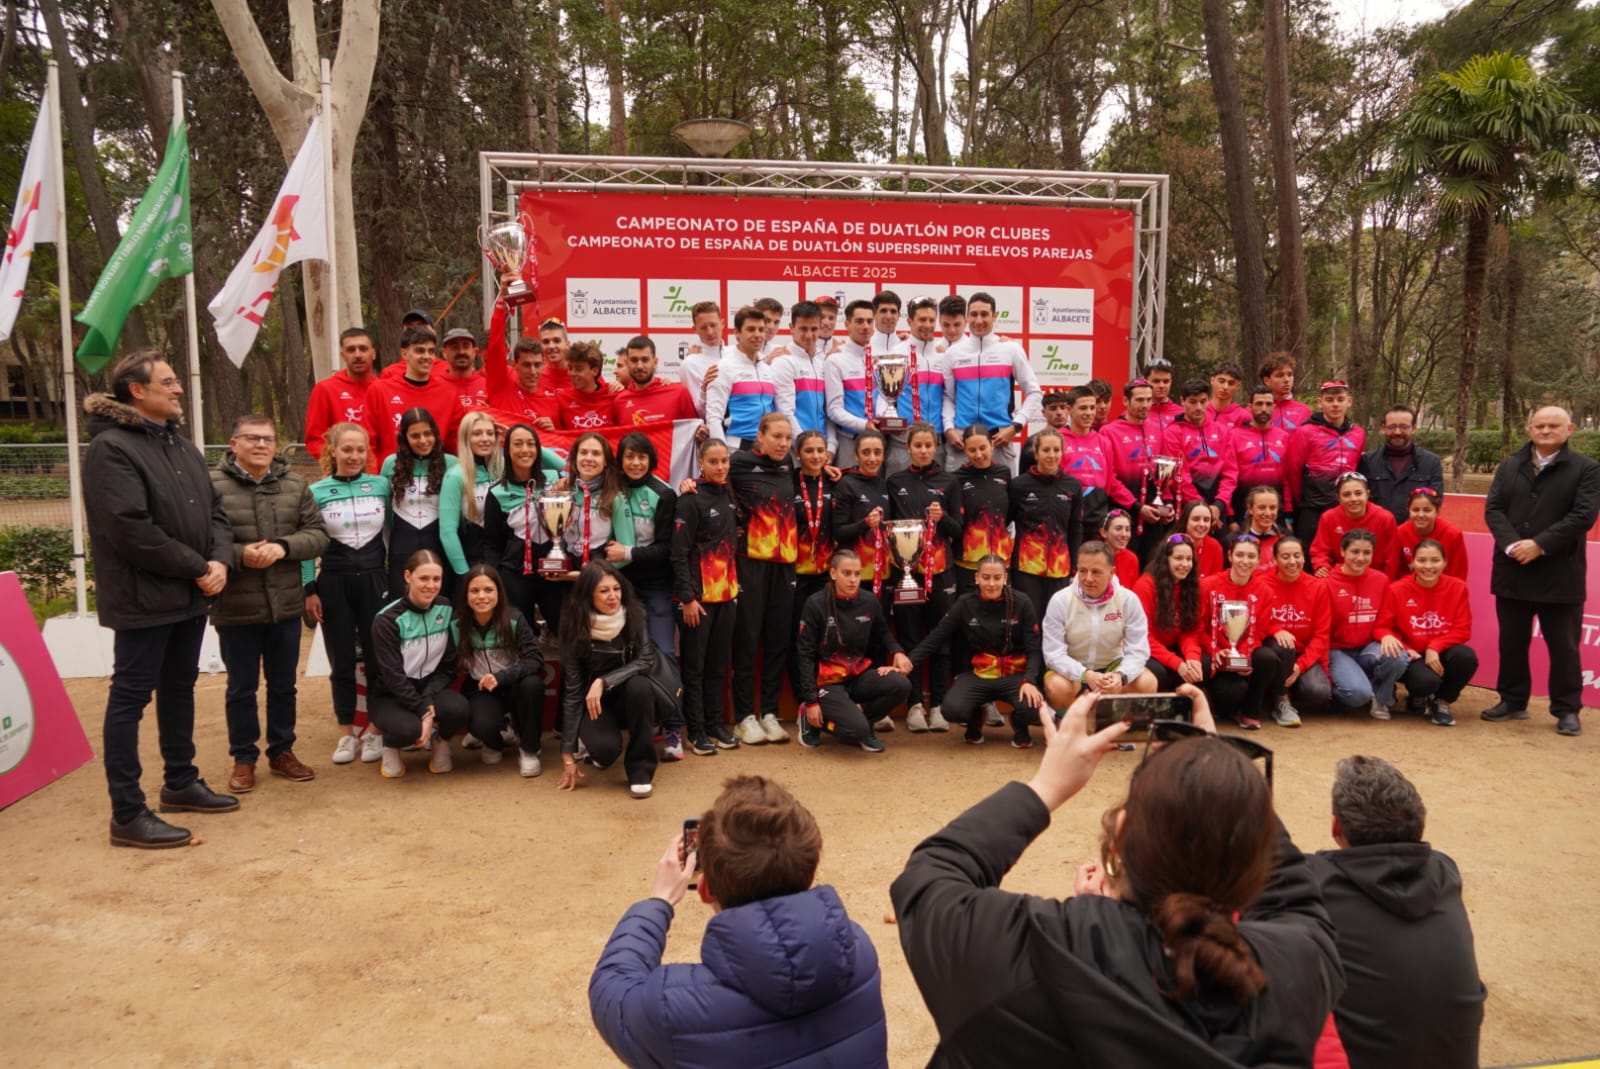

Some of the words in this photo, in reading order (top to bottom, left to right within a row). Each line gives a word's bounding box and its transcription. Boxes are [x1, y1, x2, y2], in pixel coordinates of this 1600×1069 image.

[616, 216, 739, 232] CAMPEONATO
[743, 219, 766, 233] DE
[771, 218, 838, 234] ESPAÑA
[843, 221, 865, 235] DE
[869, 222, 948, 238] DUATLÓN
[952, 225, 986, 239] POR
[990, 226, 1051, 241] CLUBES
[567, 235, 676, 249] CAMPEONATO
[680, 237, 700, 249] DE
[704, 236, 765, 251] ESPAÑA
[768, 239, 788, 252] DE
[792, 238, 863, 253] DUATLÓN
[866, 241, 962, 256] SUPERSPRINT
[965, 244, 1029, 258] RELEVOS
[1032, 246, 1094, 261] PAREJAS
[783, 265, 858, 278] ALBACETE
[863, 266, 897, 279] 2025
[593, 307, 637, 315] ALBACETE
[1052, 315, 1090, 323] ALBACETE
